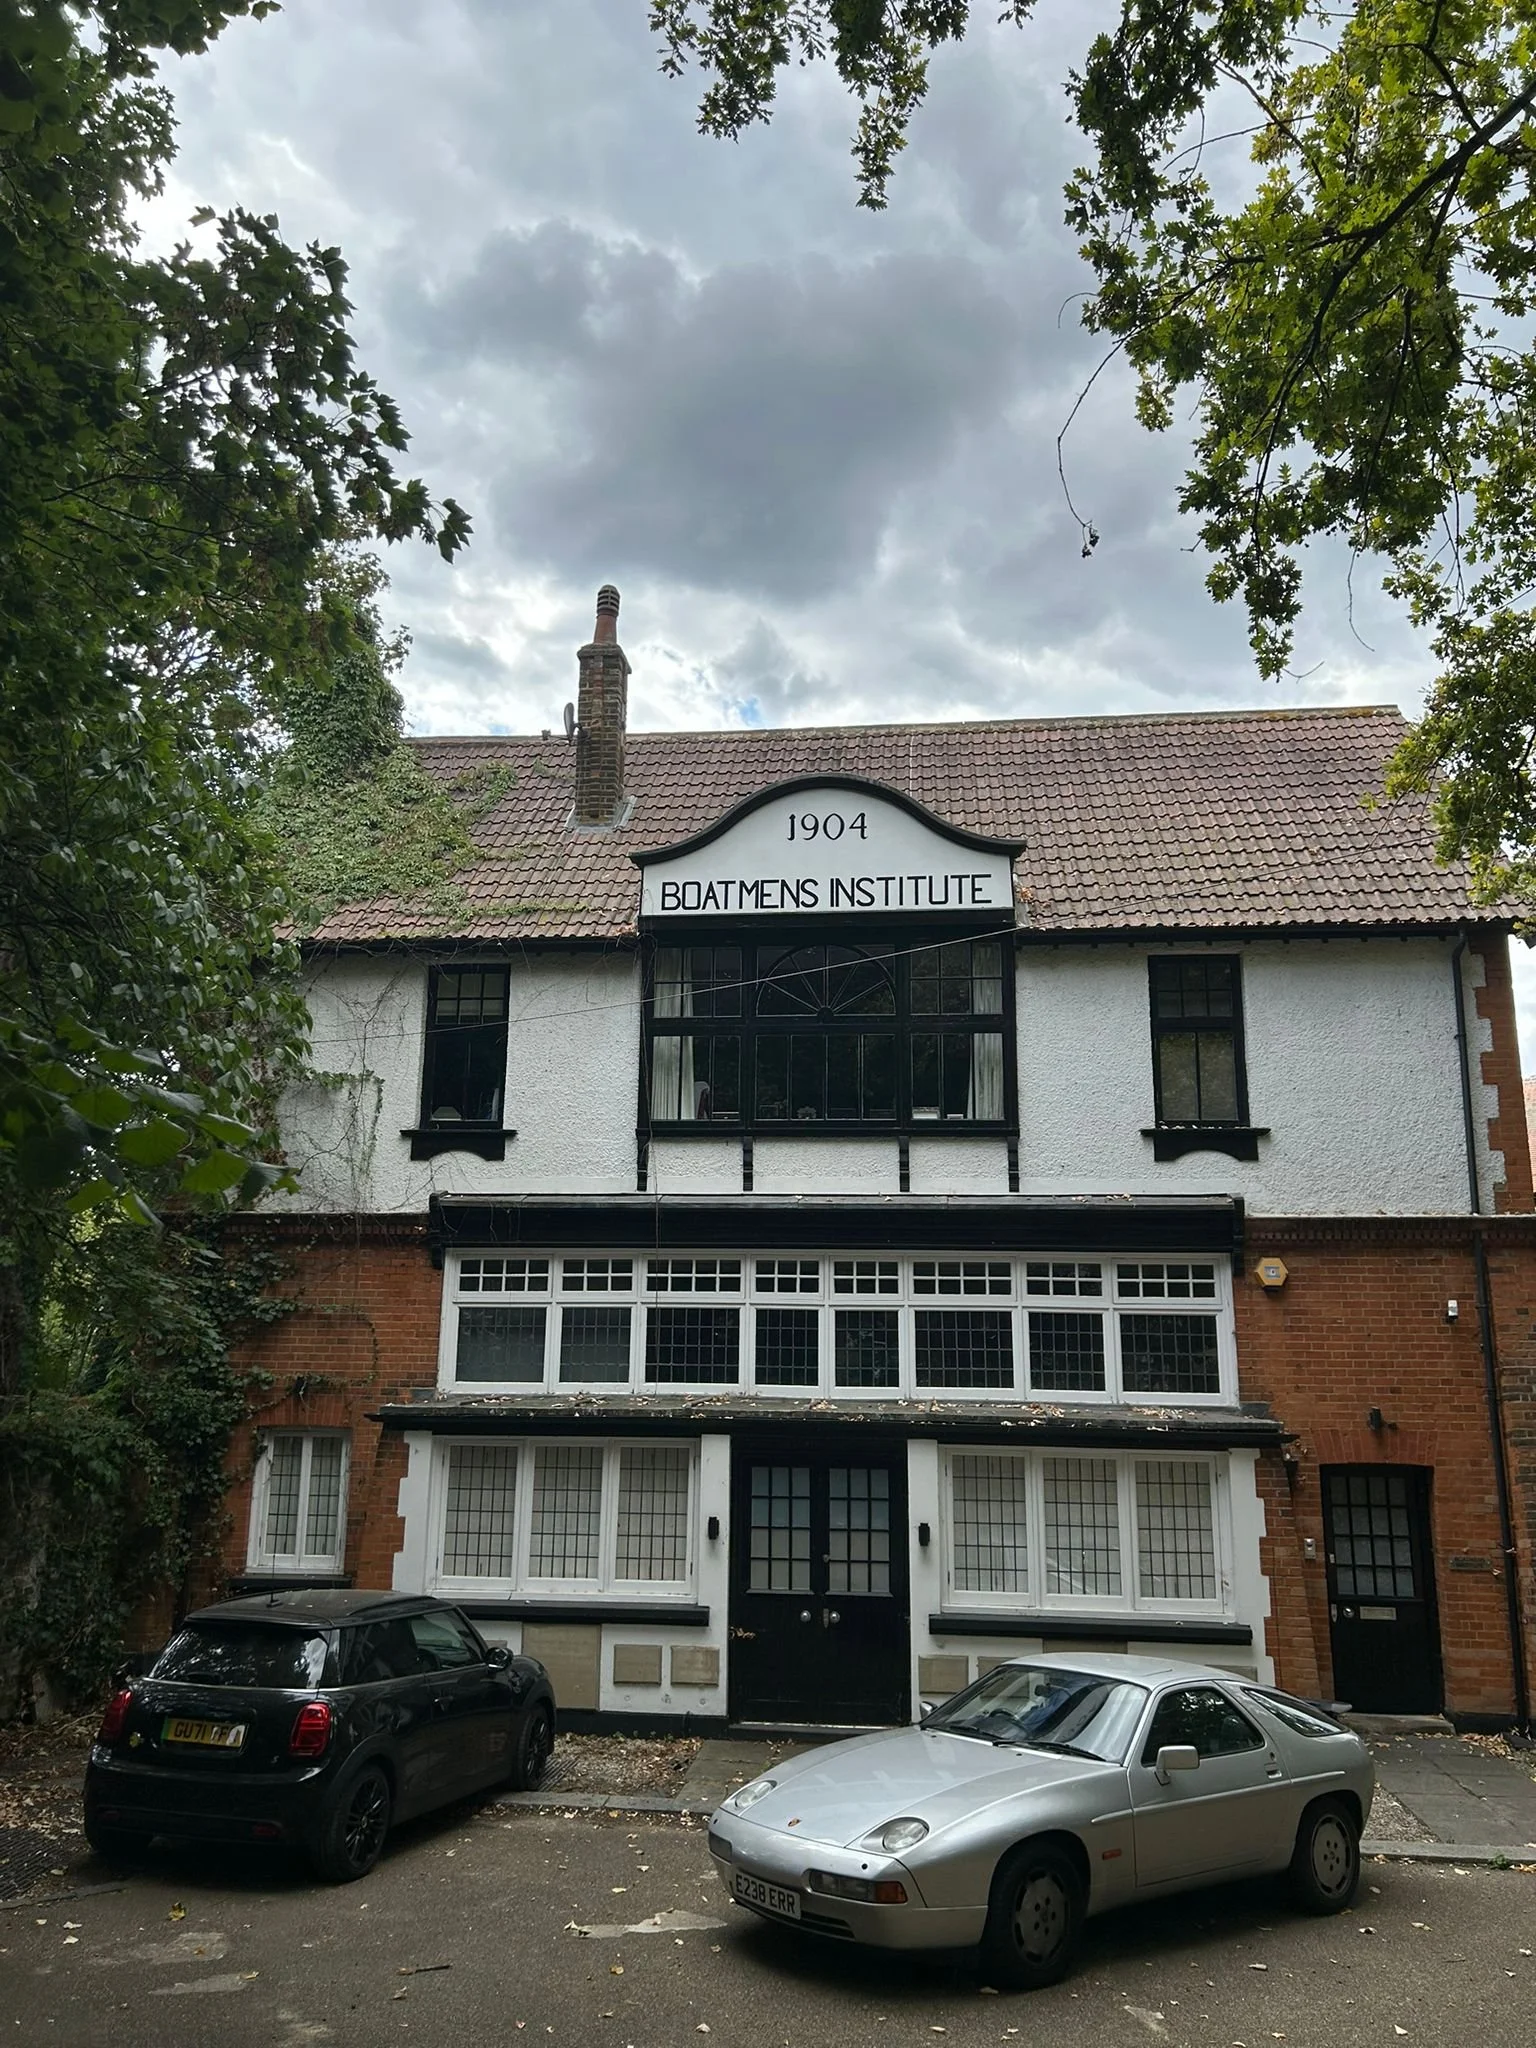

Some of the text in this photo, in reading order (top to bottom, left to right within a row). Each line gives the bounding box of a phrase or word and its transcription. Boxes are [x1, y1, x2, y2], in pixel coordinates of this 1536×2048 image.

[787, 813, 867, 840] 1904
[662, 874, 992, 910] BOATMENS INSTITUTE
[174, 1721, 208, 1740] GU71
[736, 1874, 795, 1914] E238 ERR
